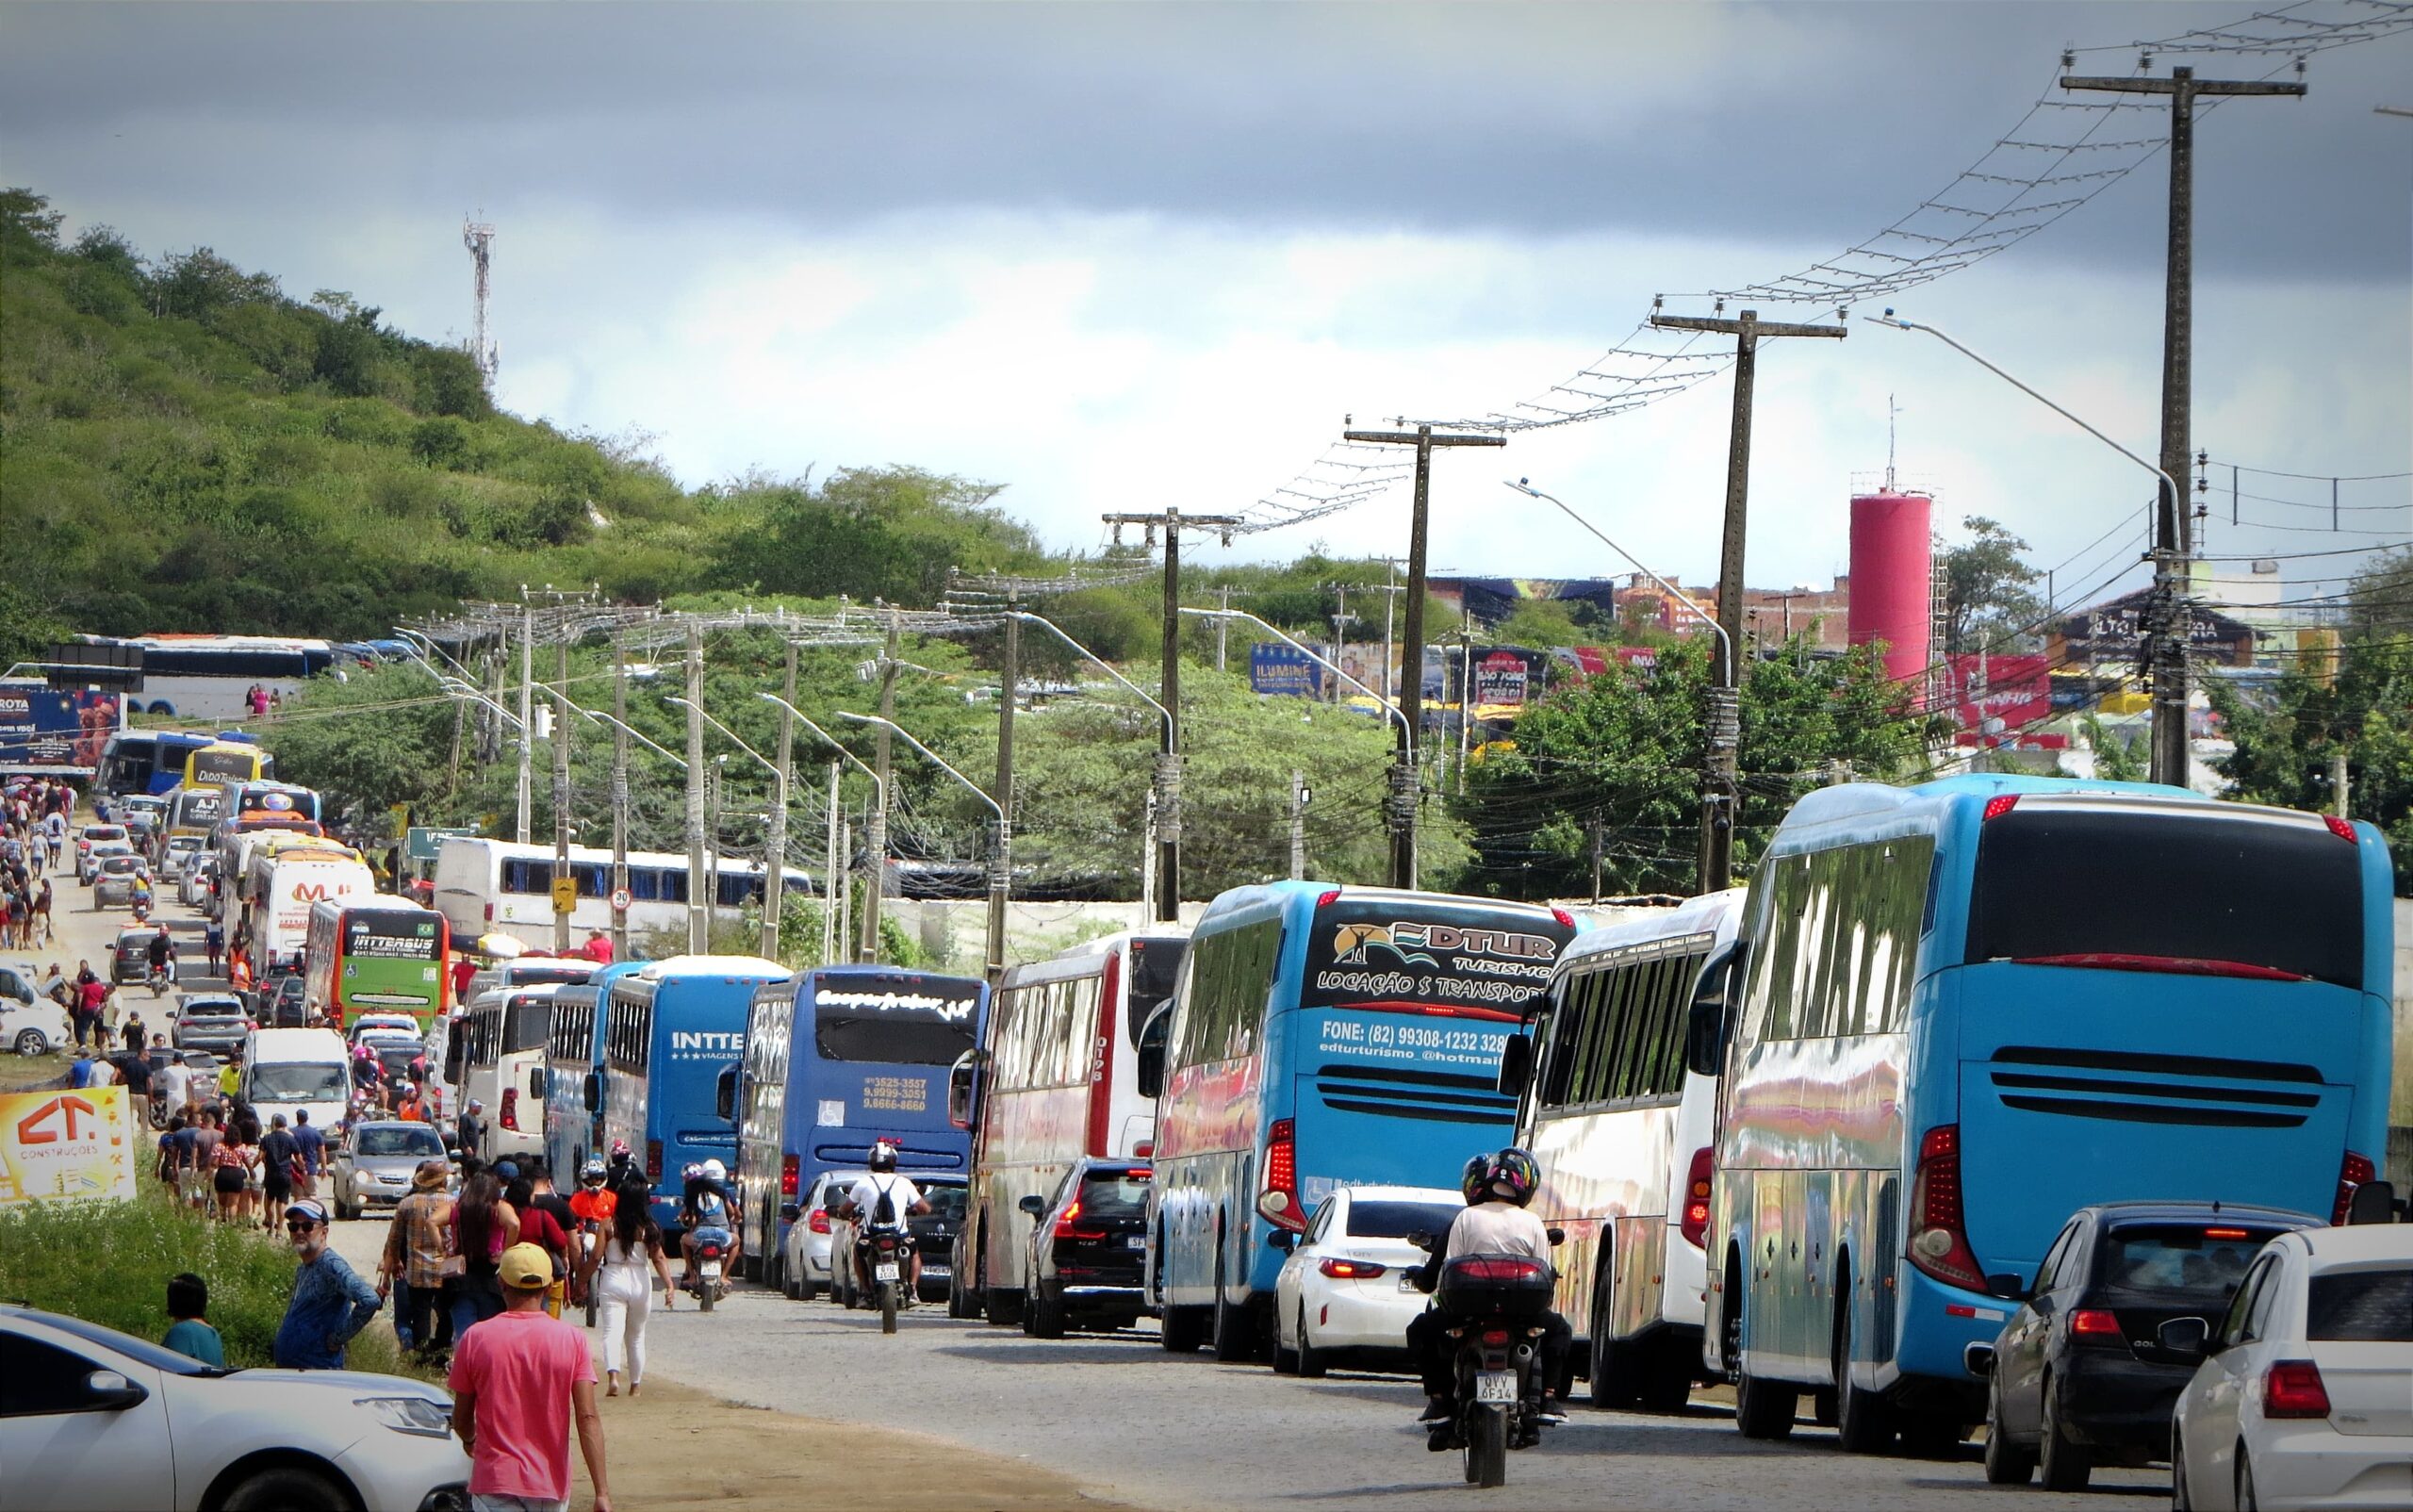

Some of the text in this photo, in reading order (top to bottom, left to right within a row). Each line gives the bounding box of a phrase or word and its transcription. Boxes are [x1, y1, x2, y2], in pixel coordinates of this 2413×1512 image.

[616, 892, 628, 901] 30
[1390, 921, 1556, 960] EDTUR
[1453, 957, 1552, 978] TURISMO
[1318, 970, 1414, 996] LOCAÇÃO
[1322, 1021, 1508, 1053] FONE: (82) 99308-1232 328
[21, 1145, 98, 1160] CONSTRUÇÕES
[2133, 1339, 2157, 1348] GOL
